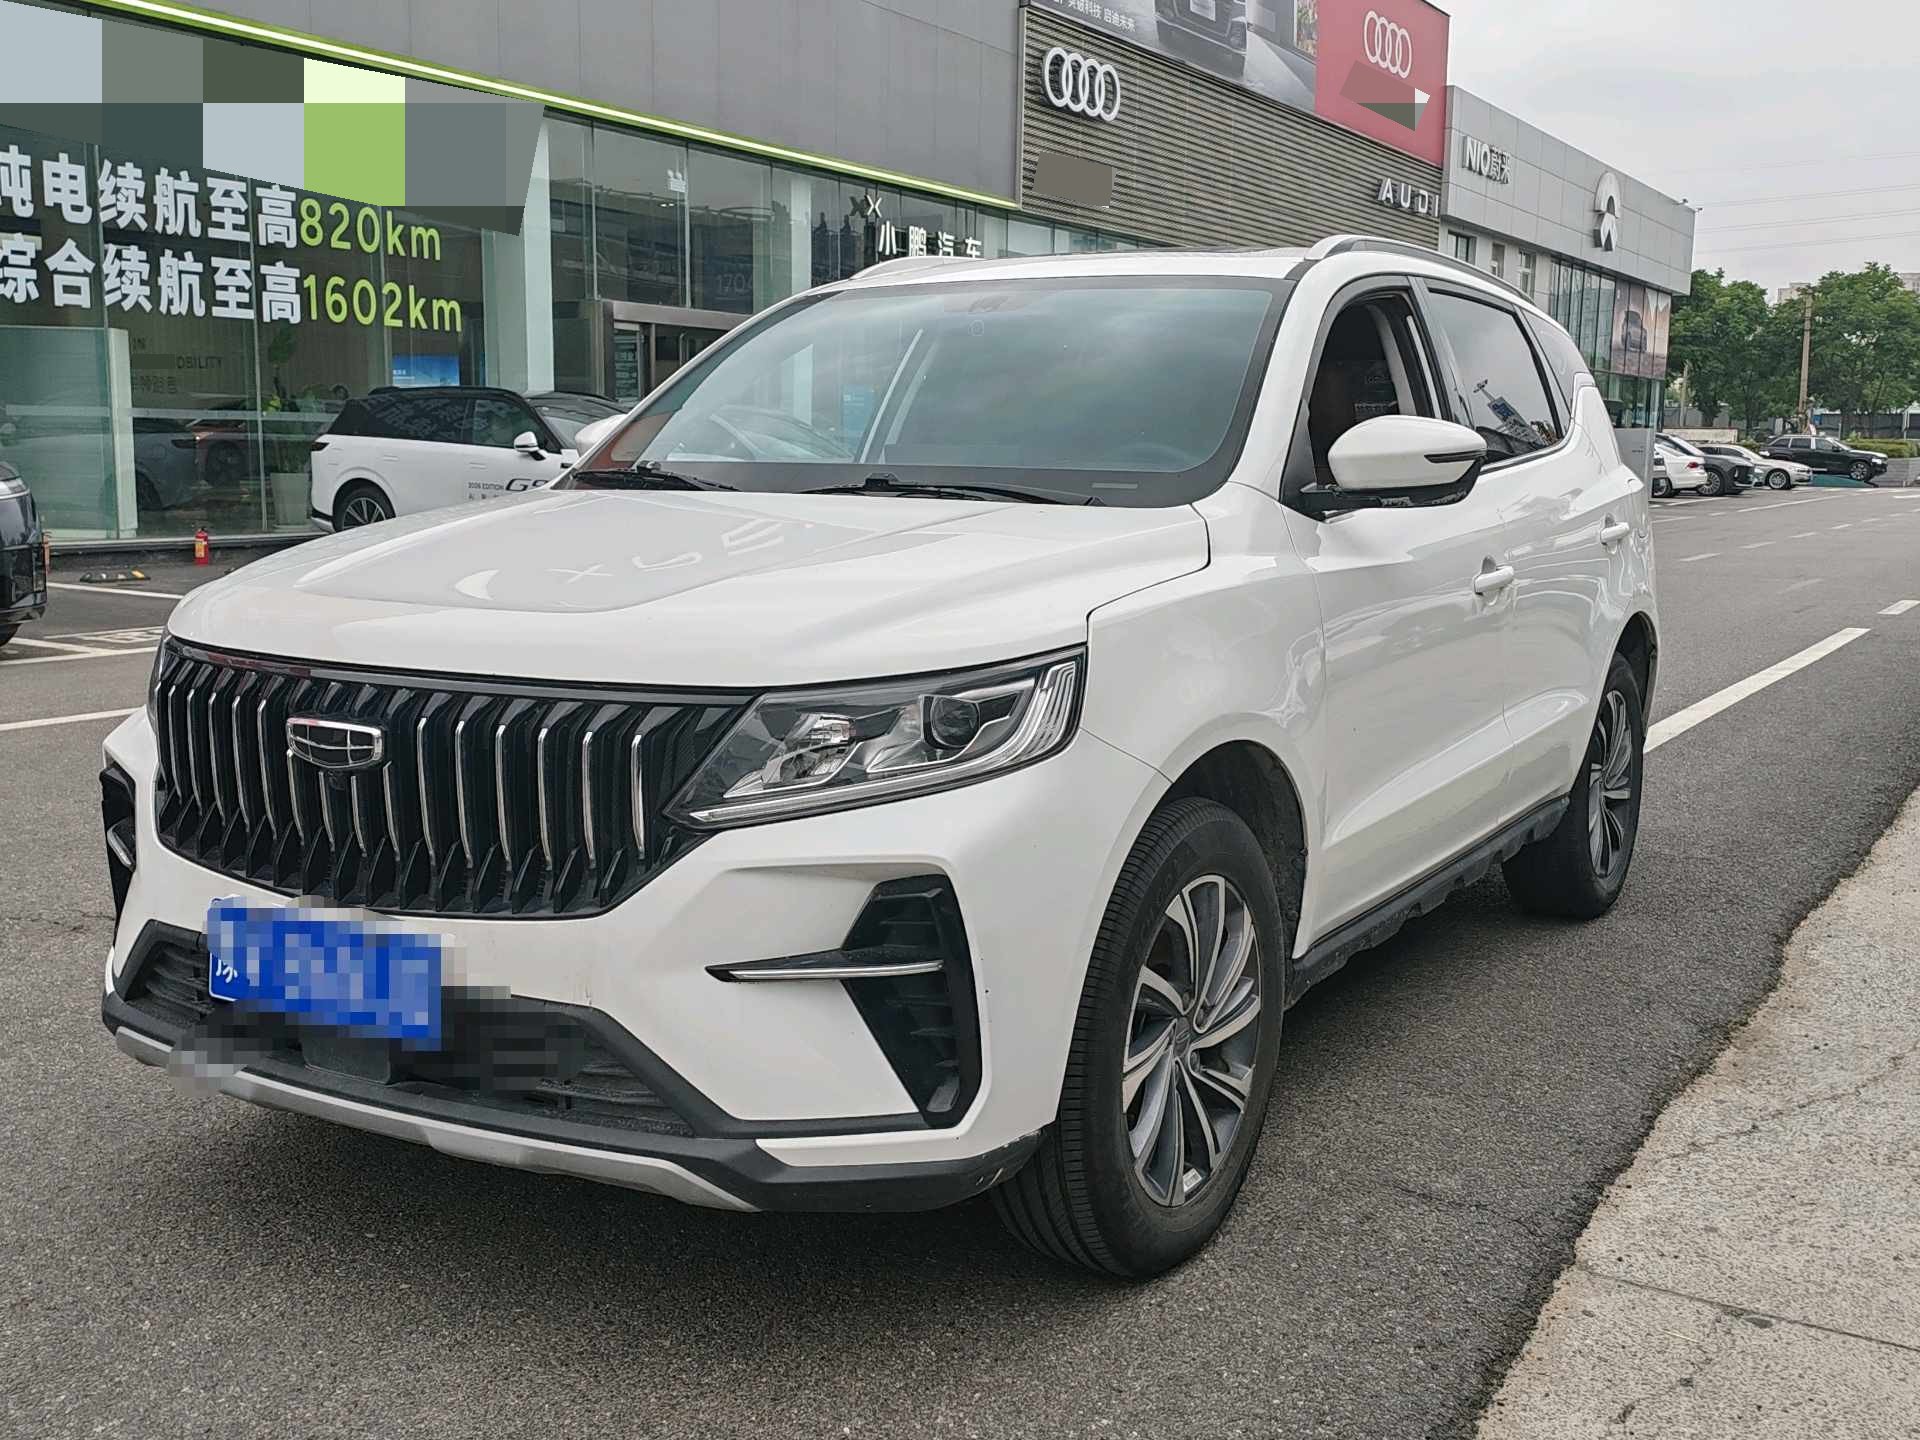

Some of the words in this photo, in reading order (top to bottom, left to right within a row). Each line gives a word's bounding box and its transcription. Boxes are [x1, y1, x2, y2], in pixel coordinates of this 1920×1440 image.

[1379, 178, 1439, 218] AUDI
[879, 220, 982, 258] 小鹏汽车
